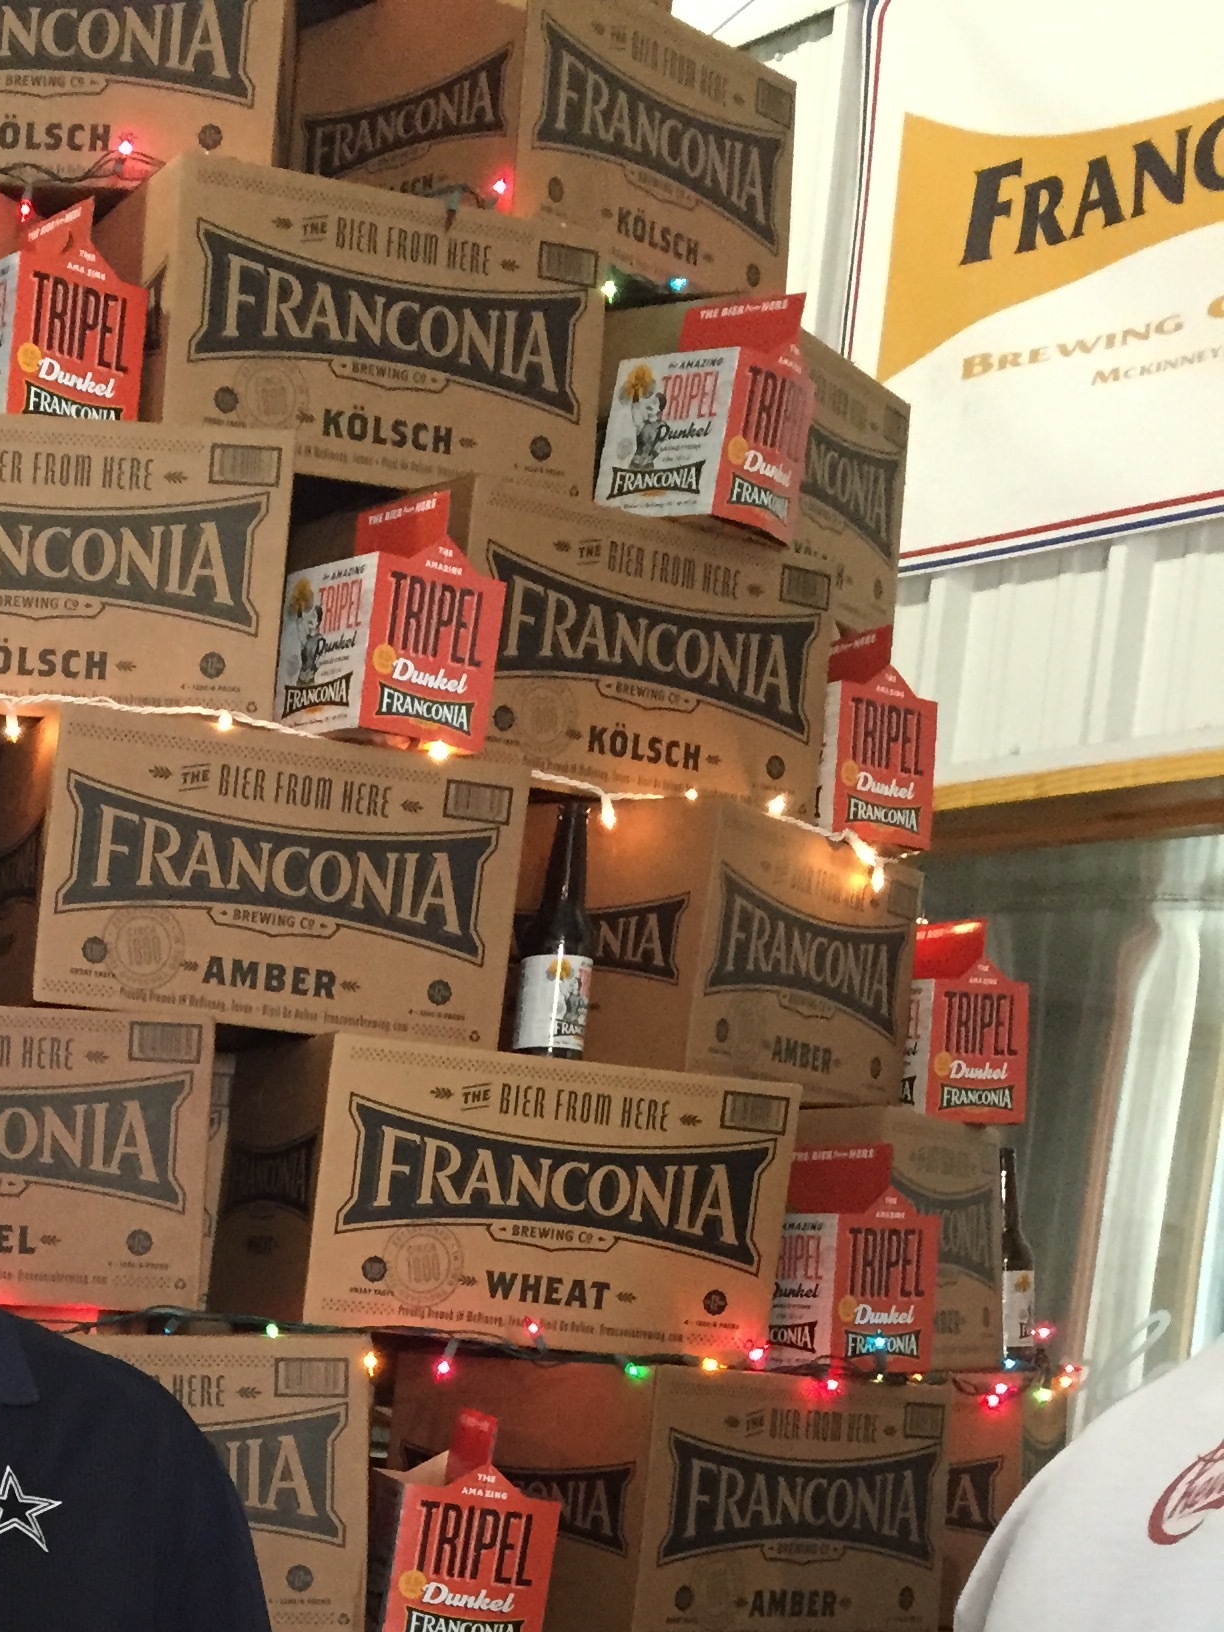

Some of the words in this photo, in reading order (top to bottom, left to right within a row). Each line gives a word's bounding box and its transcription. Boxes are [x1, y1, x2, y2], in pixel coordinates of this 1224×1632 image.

[312, 76, 495, 177] FRANCONIA
[552, 50, 767, 227] FRANCONIA
[302, 218, 329, 239] THE
[335, 215, 379, 255] BIER
[385, 225, 439, 265] FROM
[445, 236, 493, 278] HERE
[616, 205, 700, 269] KÖLSCH
[31, 269, 130, 376] TRIPEL
[220, 251, 562, 394] FRANCONIA
[961, 311, 1186, 382] BREWING
[36, 357, 117, 400] Dunkel
[351, 360, 413, 384] BREWING
[659, 367, 721, 422] TRIPEL
[321, 406, 454, 456] KÖLSCH
[31, 449, 94, 489] FROM
[101, 456, 155, 493] HERE
[612, 461, 700, 496] FRANCONIA
[578, 541, 603, 562] THE
[607, 540, 646, 576] BIER
[648, 548, 697, 588] FROM
[701, 560, 744, 601] HERE
[386, 569, 485, 671] TRIPEL
[504, 574, 793, 714] FRANCONIA
[285, 677, 351, 711] FRANCONIA
[391, 658, 469, 696] Dunkel
[615, 682, 667, 703] BREWING
[380, 686, 470, 732] FRANCONIA
[587, 722, 703, 773] KÖLSCH
[849, 695, 925, 778] TRIPEL
[180, 767, 210, 787] THE
[217, 763, 267, 802] BIER
[274, 770, 334, 811] FROM
[341, 778, 391, 819] HERE
[855, 769, 916, 802] Dunkel
[848, 796, 919, 834] FRANCONIA
[91, 803, 463, 938] FRANCONIA
[232, 907, 297, 930] BREWING
[201, 954, 338, 1000] AMBER
[726, 892, 892, 1021] FRANCONIA
[943, 989, 1019, 1059] TRIPEL
[20, 1035, 76, 1073] HERE
[771, 1034, 833, 1075] AMBER
[948, 1059, 1009, 1082] Dunkel
[461, 1086, 492, 1106] THE
[498, 1081, 547, 1119] BIER
[553, 1086, 614, 1126] FROM
[620, 1094, 671, 1133] HERE
[941, 1084, 1013, 1111] FRANCONIA
[372, 1125, 740, 1249] FRANCONIA
[509, 1222, 577, 1245] BREWING
[847, 1226, 926, 1299] TRIPEL
[484, 1269, 612, 1312] WHEAT
[853, 1303, 916, 1328] Dunkel
[684, 1457, 922, 1542] FRANCONIA
[415, 1498, 535, 1589] TRIPEL
[421, 1580, 516, 1615] Dunkel
[747, 1589, 838, 1619] AMBER
